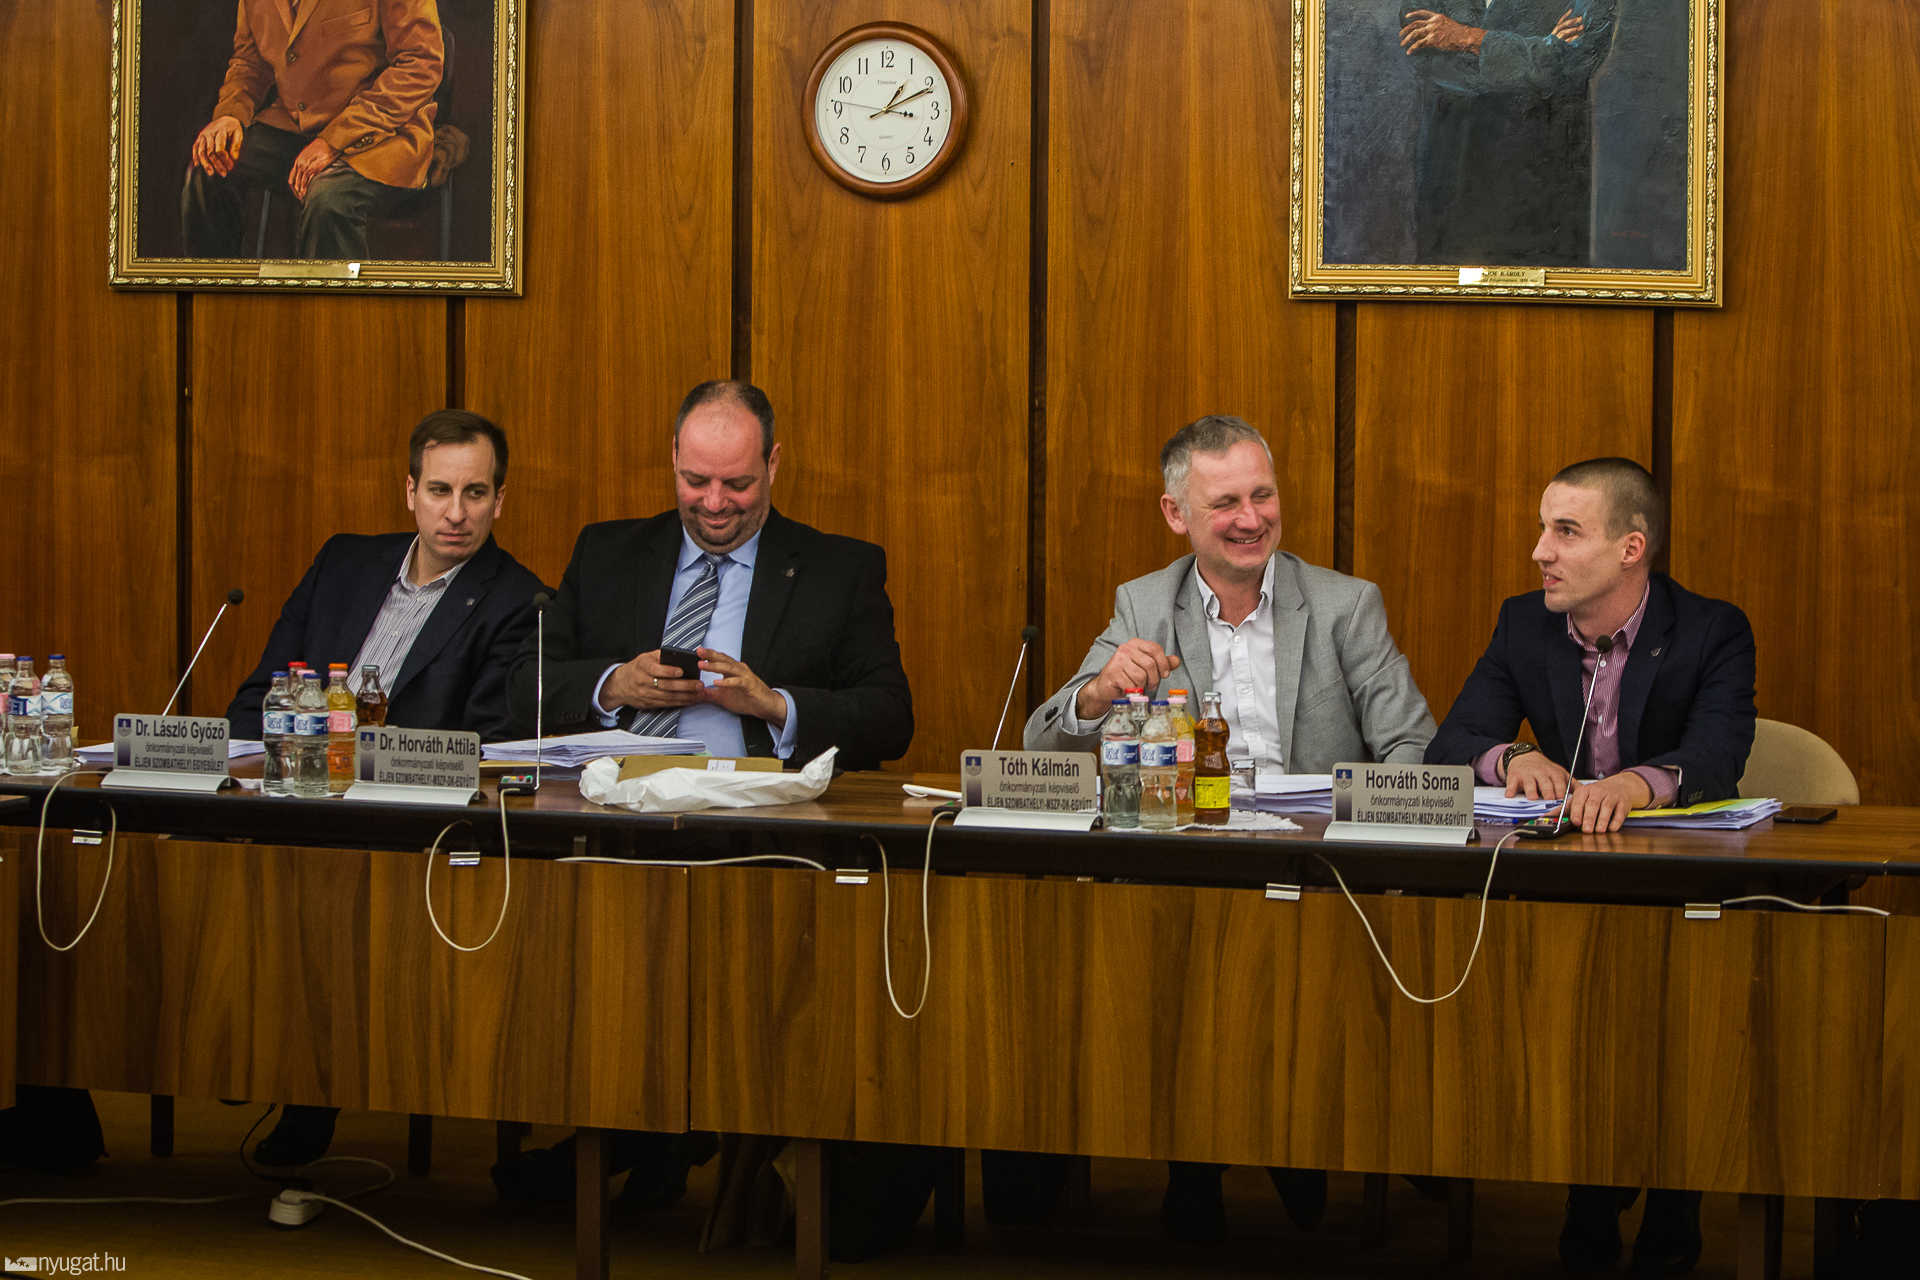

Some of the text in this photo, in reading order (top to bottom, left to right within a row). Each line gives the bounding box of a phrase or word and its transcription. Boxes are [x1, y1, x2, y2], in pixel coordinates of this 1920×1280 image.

[858, 57, 869, 75] 11
[881, 50, 895, 68] 12
[839, 76, 852, 94] 10
[924, 76, 934, 94] 2
[834, 101, 843, 119] 9
[930, 101, 940, 120] 3
[840, 126, 849, 145] 8
[923, 126, 934, 146] 4
[857, 146, 867, 163] 7
[881, 153, 891, 171] 6
[905, 146, 915, 164] 5
[135, 719, 225, 743] Dr. László Győző
[379, 733, 476, 755] Dr. Horváth Attila
[999, 757, 1080, 777] Tóth Kálmán
[1366, 769, 1459, 791] Horváth Soma
